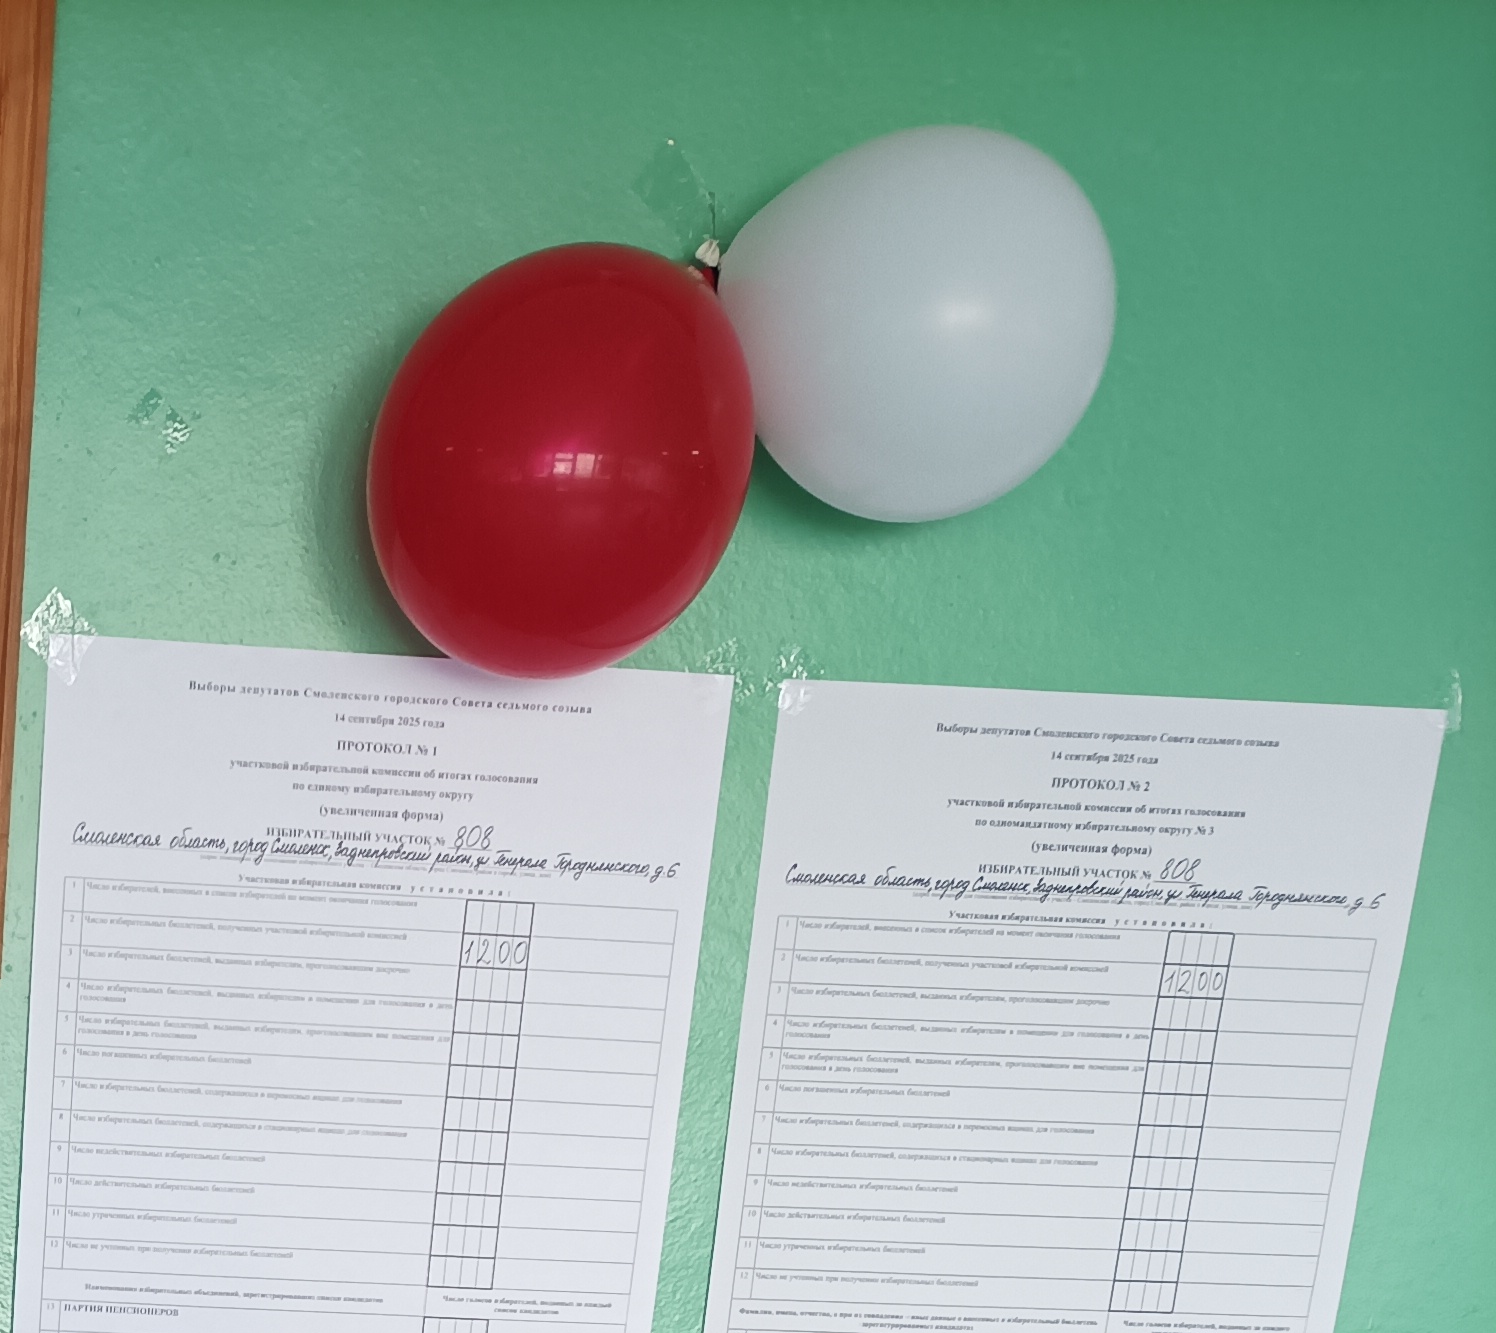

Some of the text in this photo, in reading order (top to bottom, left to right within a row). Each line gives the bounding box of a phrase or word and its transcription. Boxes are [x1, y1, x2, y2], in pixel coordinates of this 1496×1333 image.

[188, 680, 592, 714] Выборы депутатов Смоленского городского Совета седьмого созыва
[335, 713, 346, 723] 14
[397, 715, 421, 728] 2025
[422, 719, 445, 729] года
[936, 722, 1280, 748] Выборы депутатов Смоленского городского Совета седьмого созыва
[337, 740, 412, 755] ПРОТОКОЛ
[1050, 751, 1062, 761] 14
[1111, 752, 1135, 764] 2025
[1136, 756, 1159, 765] года
[229, 759, 539, 785] участковой избирательной комиссии об итогах голосования
[292, 782, 474, 803] по единому избирательному округу
[1051, 777, 1125, 791] ПРОТОКОЛ
[319, 805, 444, 823] (увеличенная форма)
[947, 798, 1246, 818] участковой избирательной комиссии об итогах голосования
[266, 827, 372, 842] ИЗБИРАТЕЛЬНЫЙ
[375, 833, 431, 846] УЧАСТОК
[454, 825, 494, 849] 808
[974, 819, 988, 827] по
[989, 819, 1073, 832] одномандатному
[1074, 820, 1157, 836] избирательному
[1158, 826, 1193, 837] округу
[1031, 840, 1153, 858] (увеличенная форма)
[978, 863, 1080, 877] ИЗБИРАТЕЛЬНЫЙ
[1083, 867, 1137, 880] УЧАСТОК
[1159, 857, 1202, 882] 808
